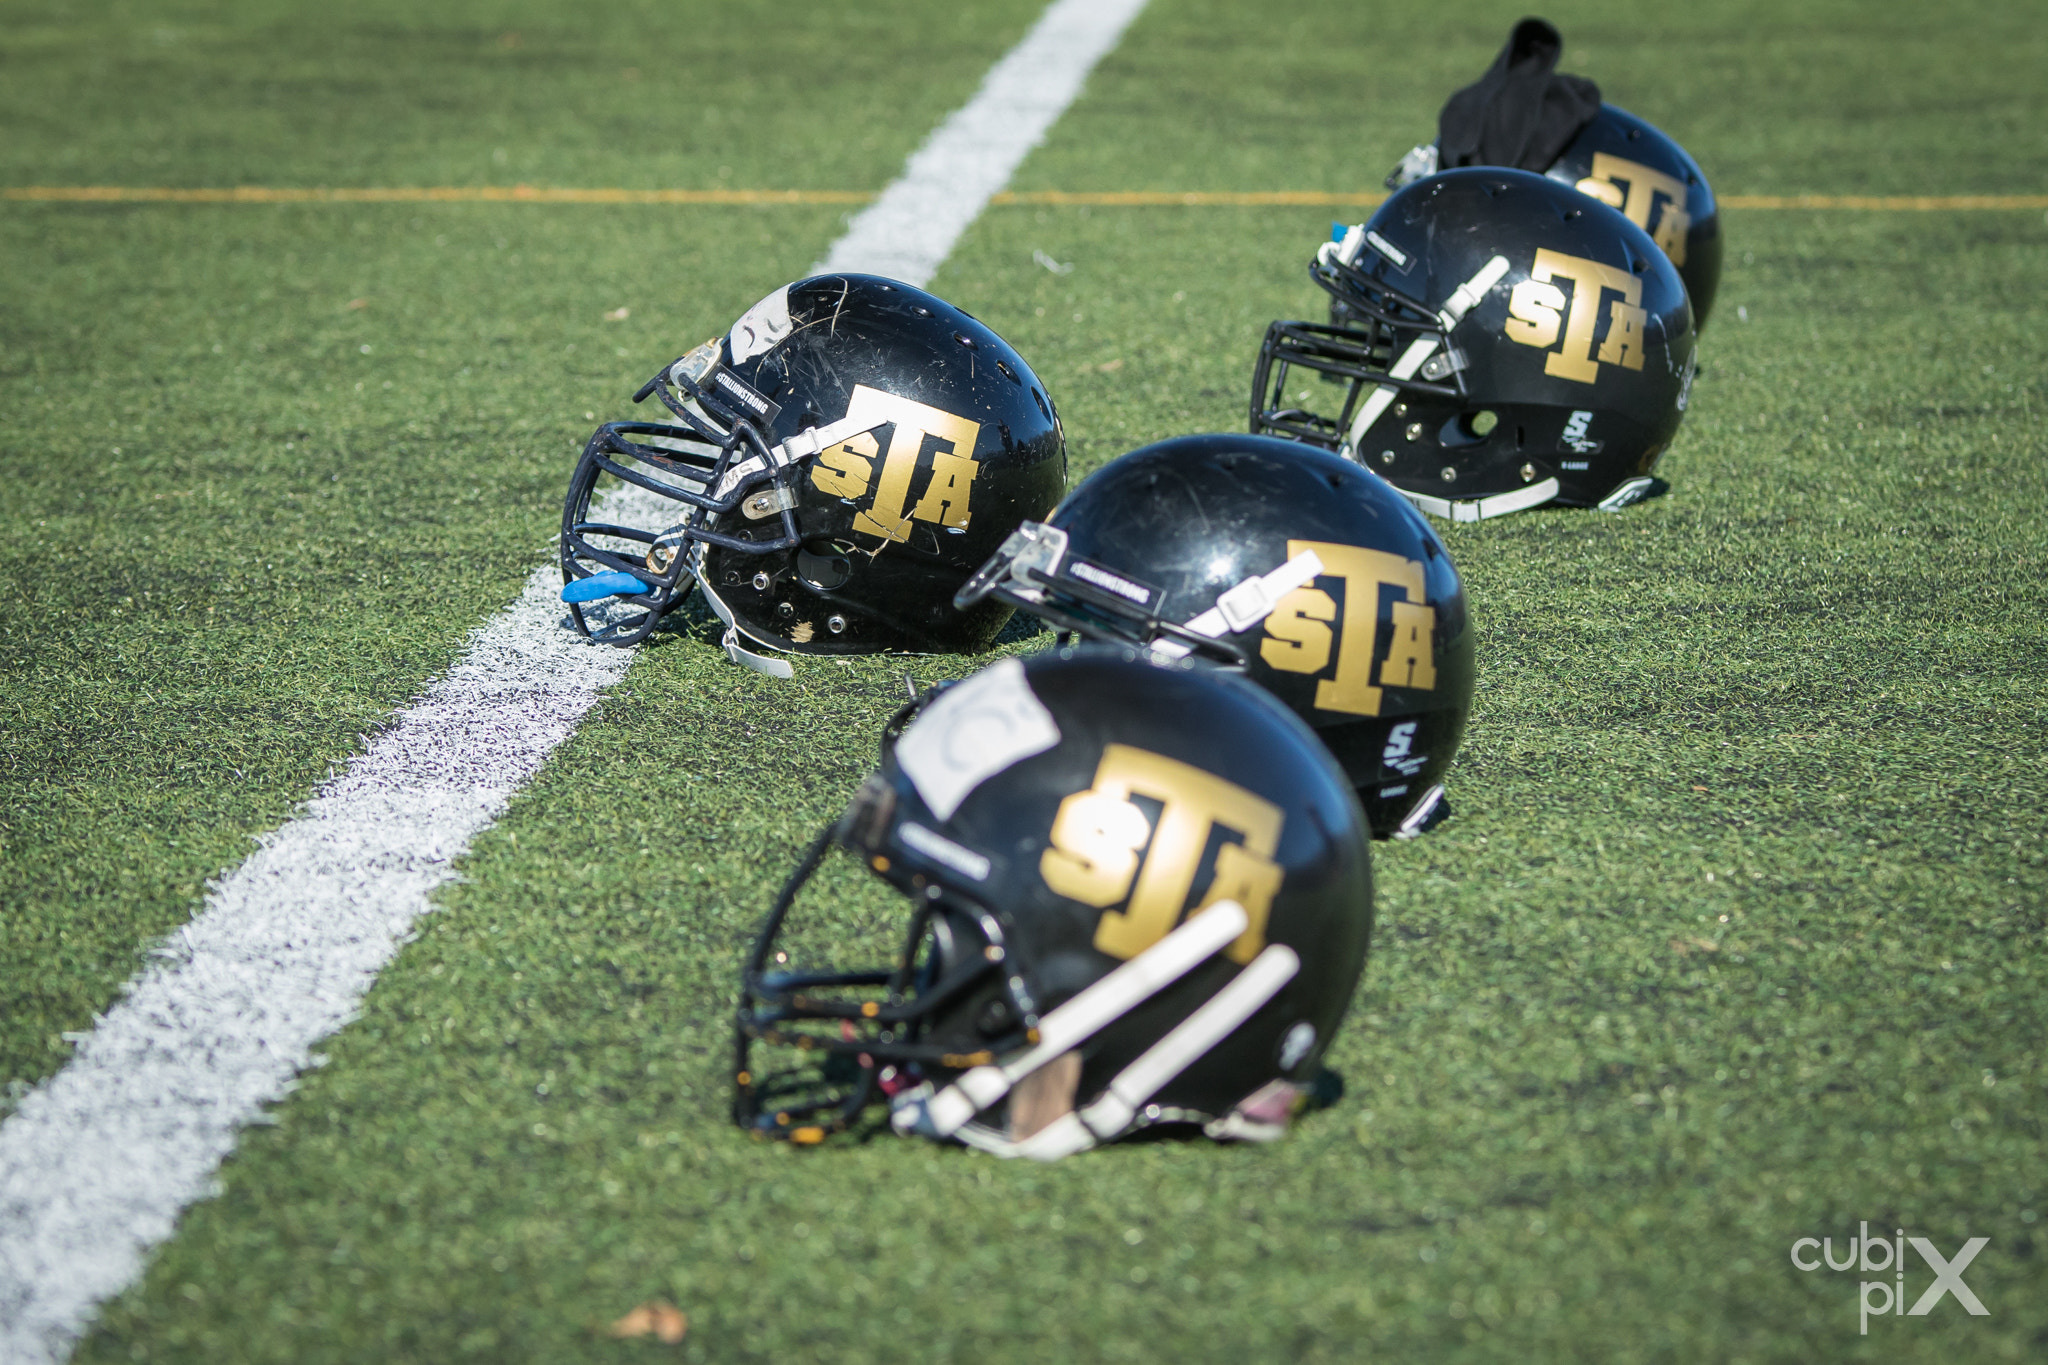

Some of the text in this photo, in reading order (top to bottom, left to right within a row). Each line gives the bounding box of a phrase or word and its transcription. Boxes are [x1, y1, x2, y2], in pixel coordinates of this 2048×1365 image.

[714, 371, 769, 415] #STALLIONSTRONG
[1504, 247, 1648, 384] STA
[810, 383, 981, 543] STA
[1259, 539, 1438, 717] STA
[1039, 742, 1285, 967] STA
